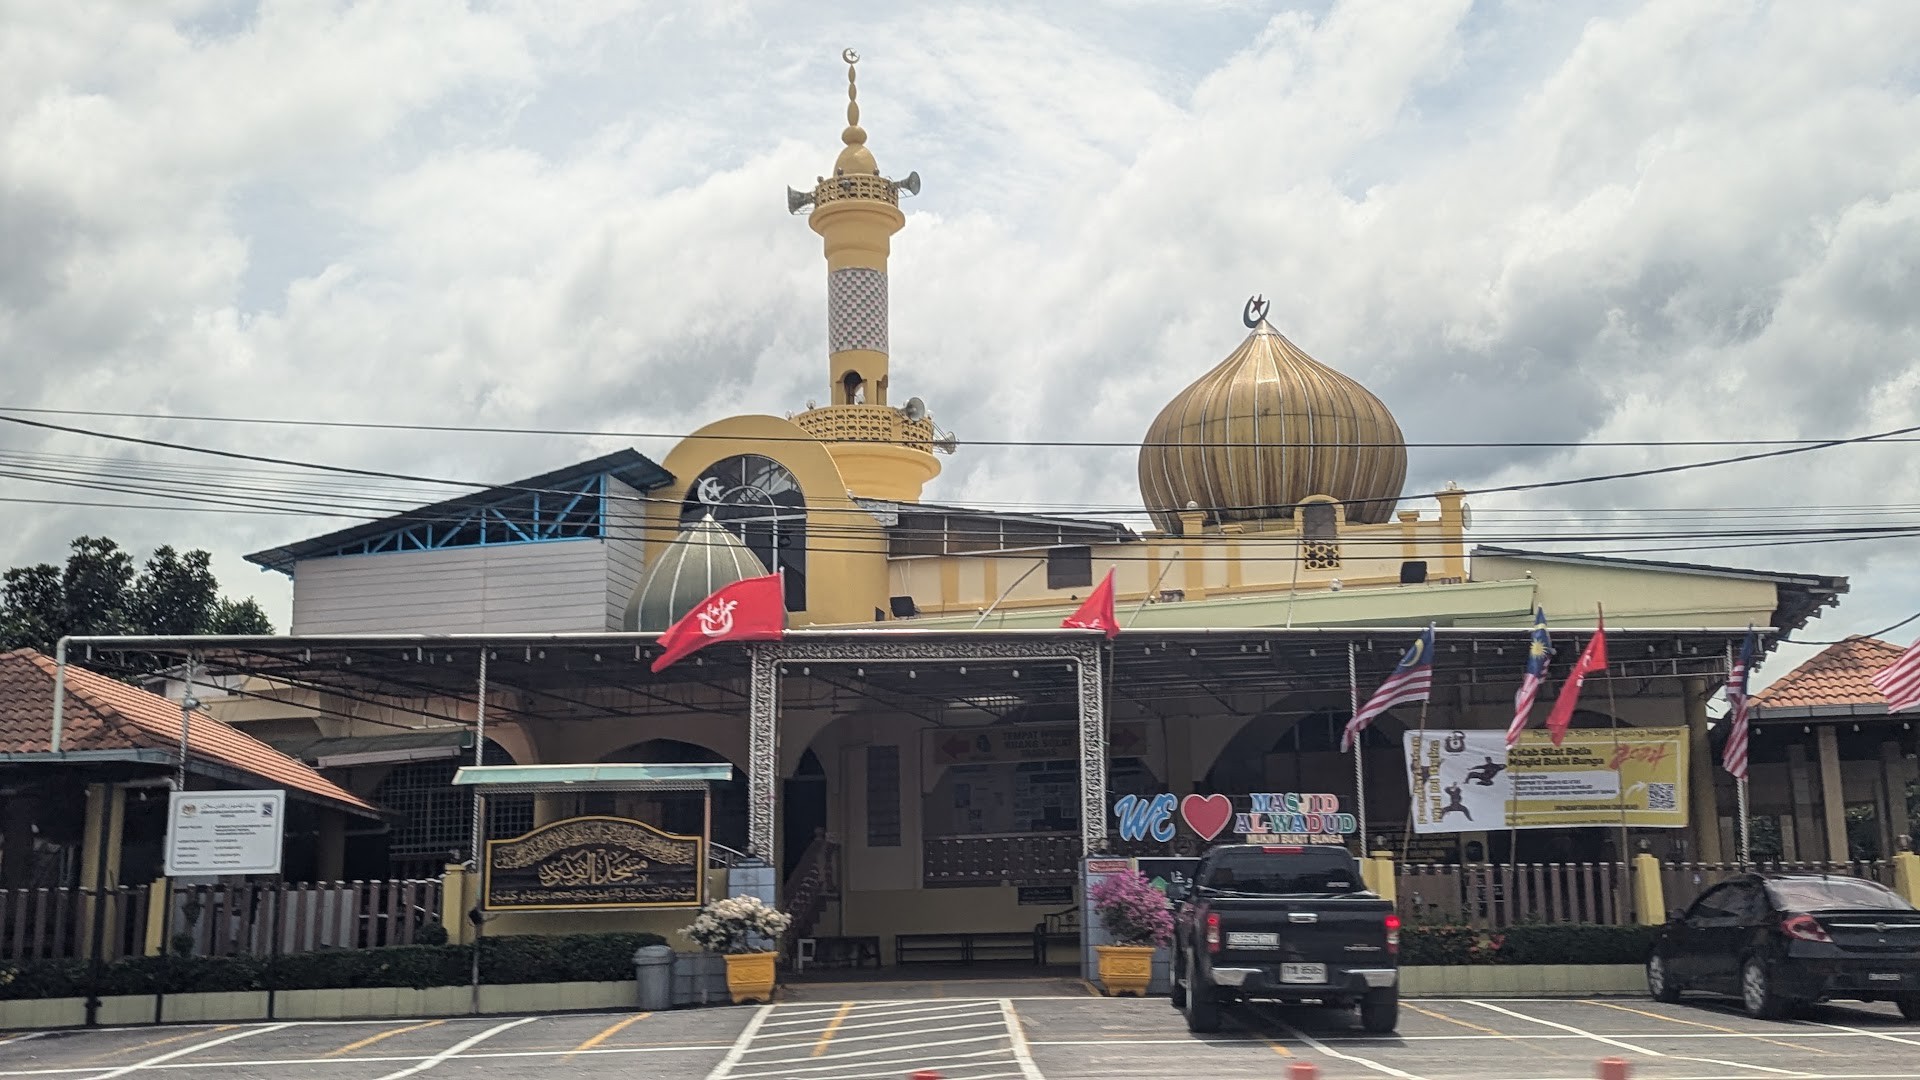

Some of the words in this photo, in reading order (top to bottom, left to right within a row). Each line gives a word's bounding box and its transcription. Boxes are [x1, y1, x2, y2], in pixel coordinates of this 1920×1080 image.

[1541, 747, 1564, 756] Silat
[1508, 757, 1541, 768] Masjid
[1543, 757, 1570, 766] Bukit
[1572, 757, 1605, 767] Bunga
[1250, 792, 1340, 814] MASJID
[1114, 793, 1178, 842] WE
[1233, 813, 1357, 834] AL-WADUD
[1281, 834, 1308, 844] BUKIT
[1311, 834, 1344, 844] BUNGA
